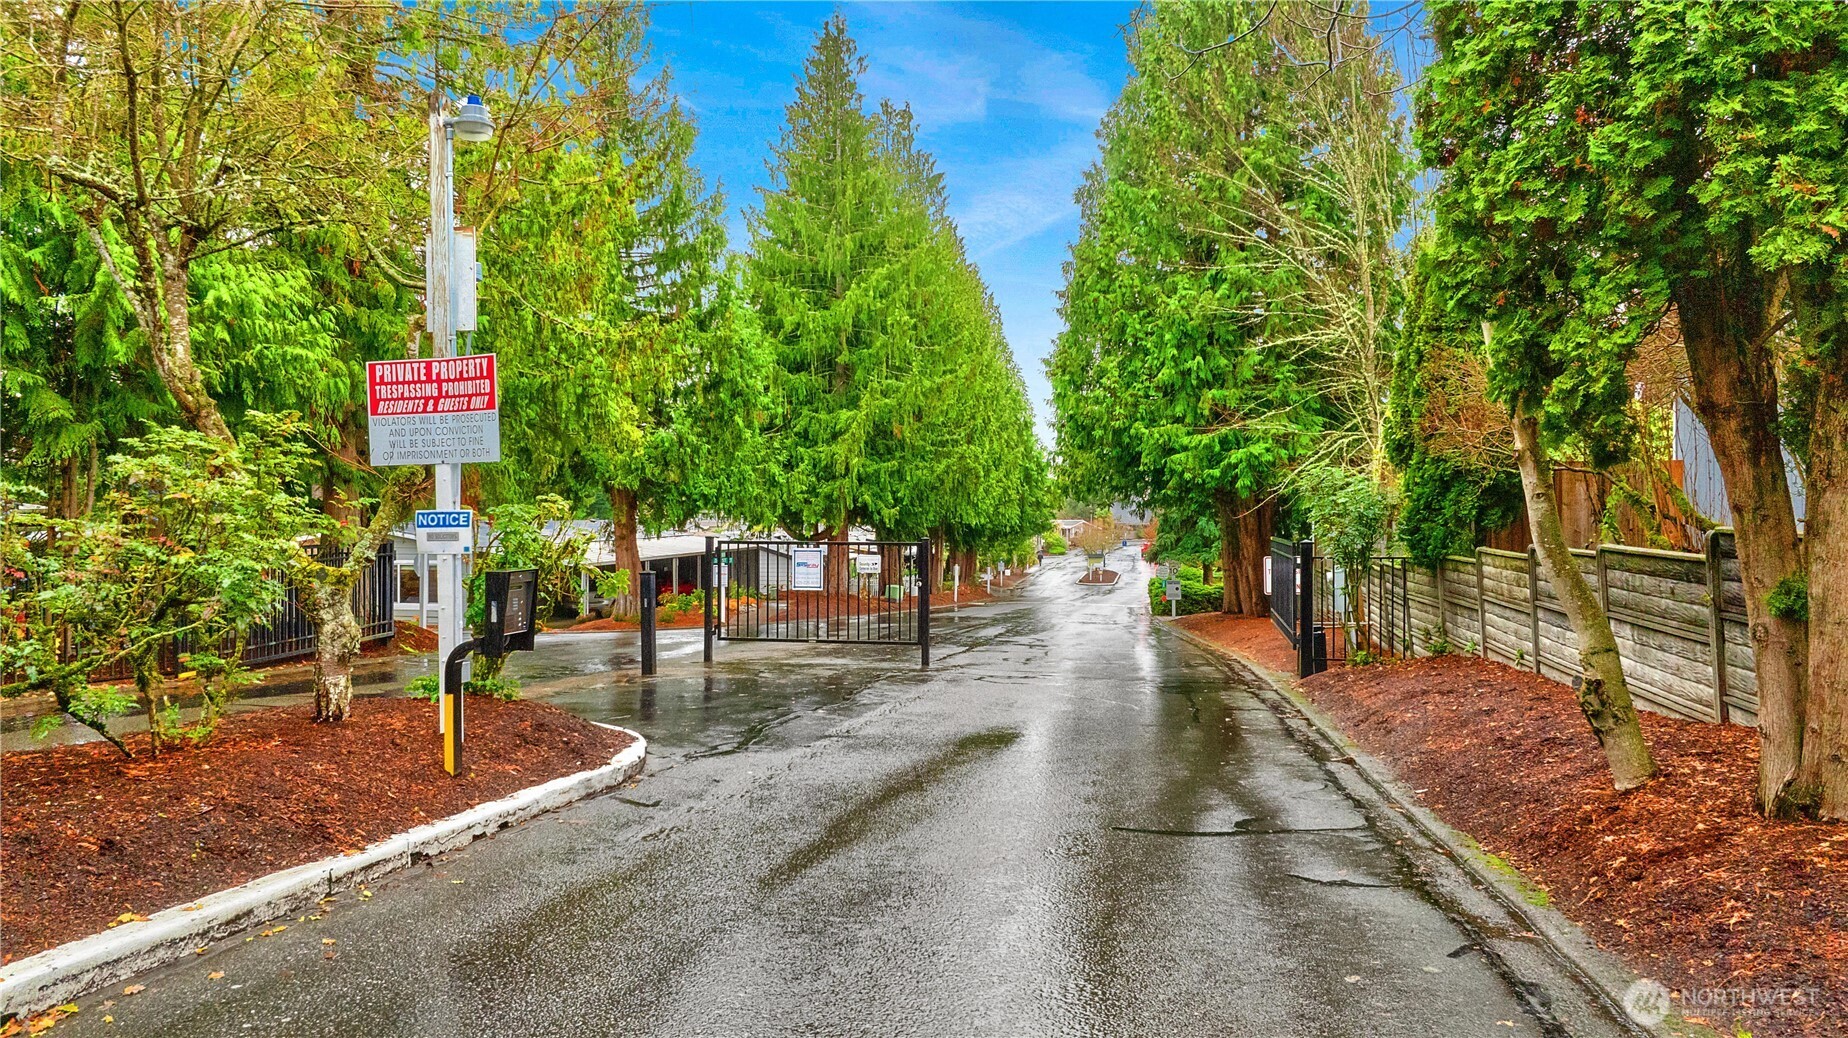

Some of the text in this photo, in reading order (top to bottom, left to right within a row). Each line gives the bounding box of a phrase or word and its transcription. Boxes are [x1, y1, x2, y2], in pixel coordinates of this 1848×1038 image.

[375, 358, 488, 382] PRIVATE PROPERTY
[375, 379, 491, 399] TRESPASSING PROHIBITED
[377, 395, 490, 414] RESIDENTS & GUESTS ONLY
[372, 412, 497, 427] VIOLATORS WILL BE PROSECUTED
[388, 425, 484, 437] AND UPON CONVICTION
[388, 436, 484, 449] WILL BE SUBJECT TO FINE
[382, 447, 491, 461] OR IMPRISONMENT OR BOTH
[418, 514, 468, 525] NOTICE
